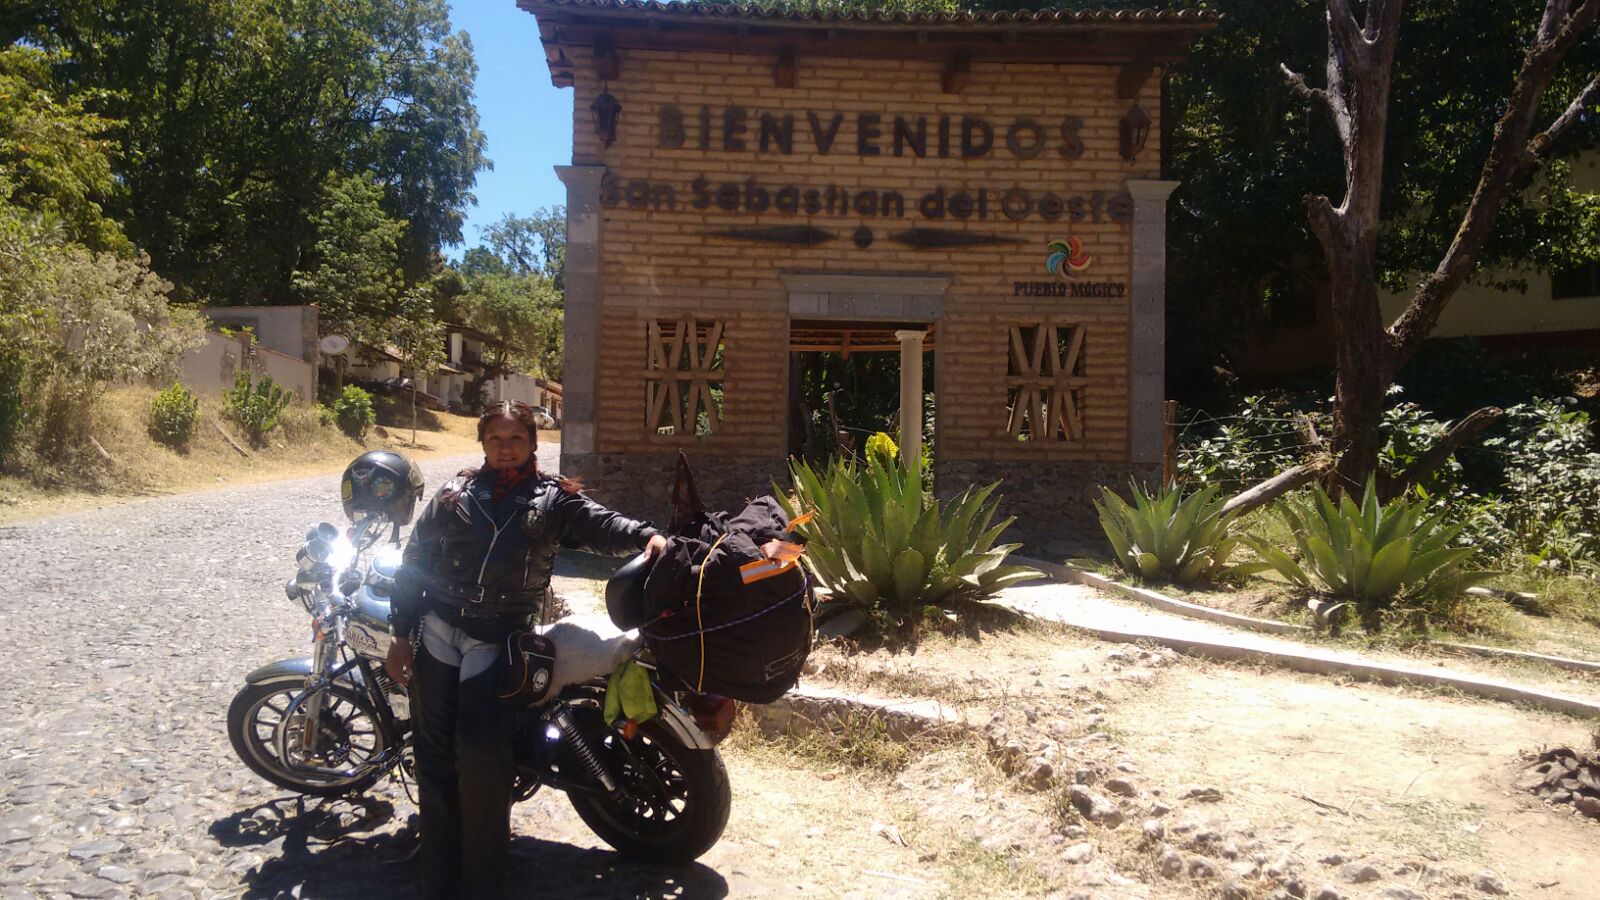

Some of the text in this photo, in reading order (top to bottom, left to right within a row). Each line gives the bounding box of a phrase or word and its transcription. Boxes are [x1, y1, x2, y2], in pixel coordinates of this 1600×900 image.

[657, 104, 1085, 159] BIENVENIDOS
[599, 171, 675, 209] San
[919, 184, 988, 220] del
[1002, 187, 1135, 224] Oeste
[1014, 281, 1066, 297] PUEBLO
